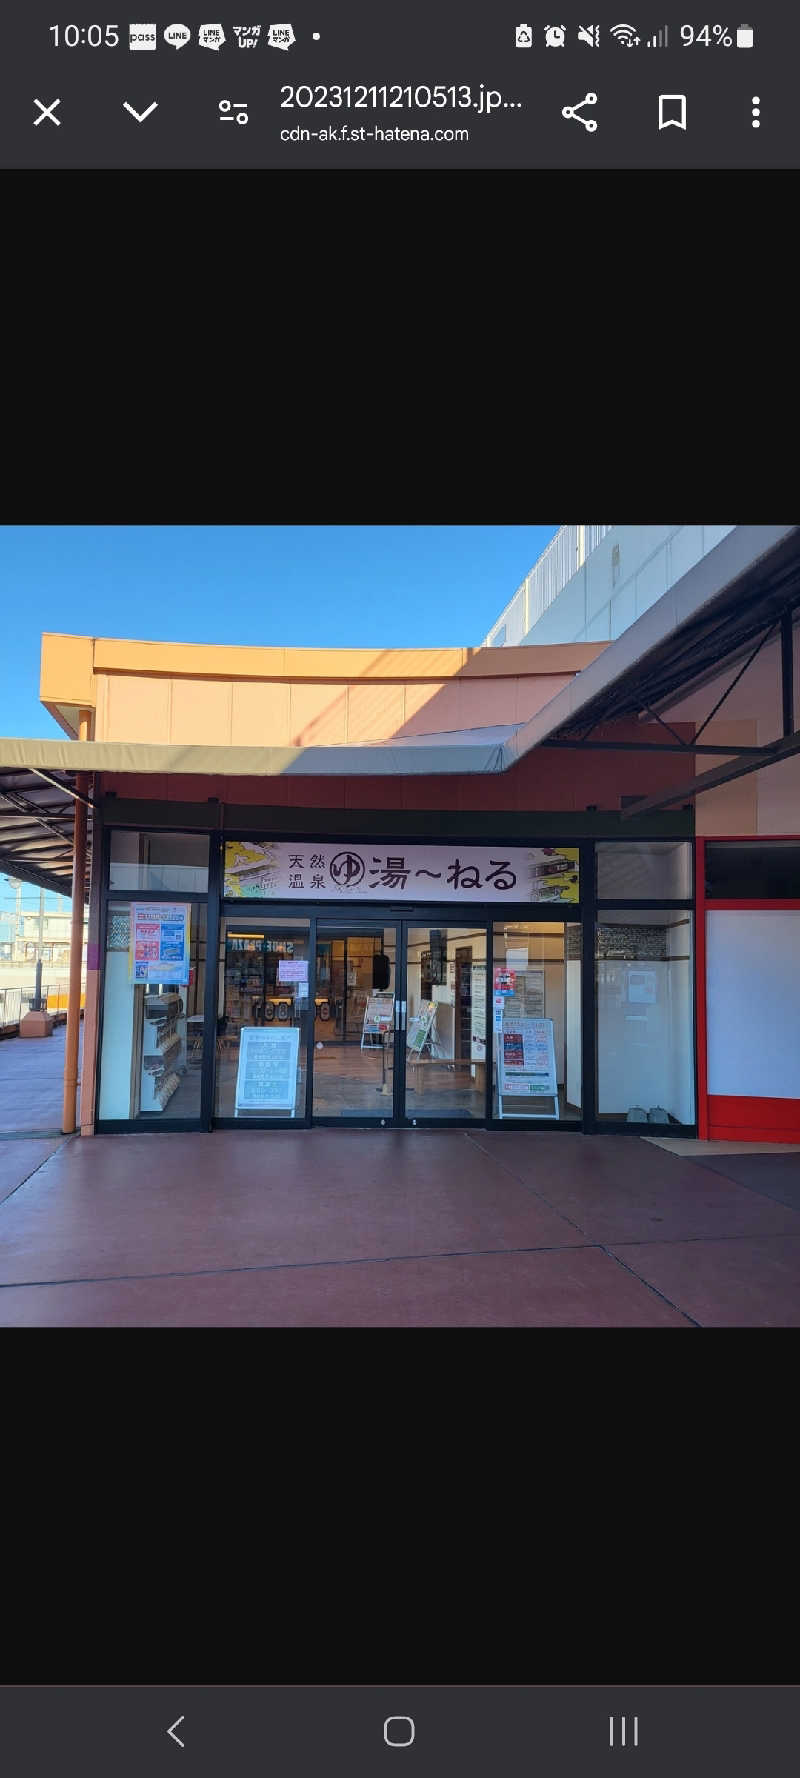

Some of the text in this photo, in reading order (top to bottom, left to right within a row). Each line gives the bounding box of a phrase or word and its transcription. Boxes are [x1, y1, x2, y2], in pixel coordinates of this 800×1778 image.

[49, 24, 119, 48] 10:05
[168, 31, 188, 40] LINE
[203, 29, 220, 37] LINE
[232, 25, 262, 37] マンガ
[272, 29, 290, 37] LINE
[680, 24, 733, 48] 94%
[129, 33, 156, 43] pass
[238, 37, 258, 49] UP!
[280, 83, 523, 114] 20231211210513.jp...
[280, 124, 469, 142] cdn-ak.f.st-hatena.com
[288, 854, 327, 869] 天然
[288, 873, 327, 889] 温泉
